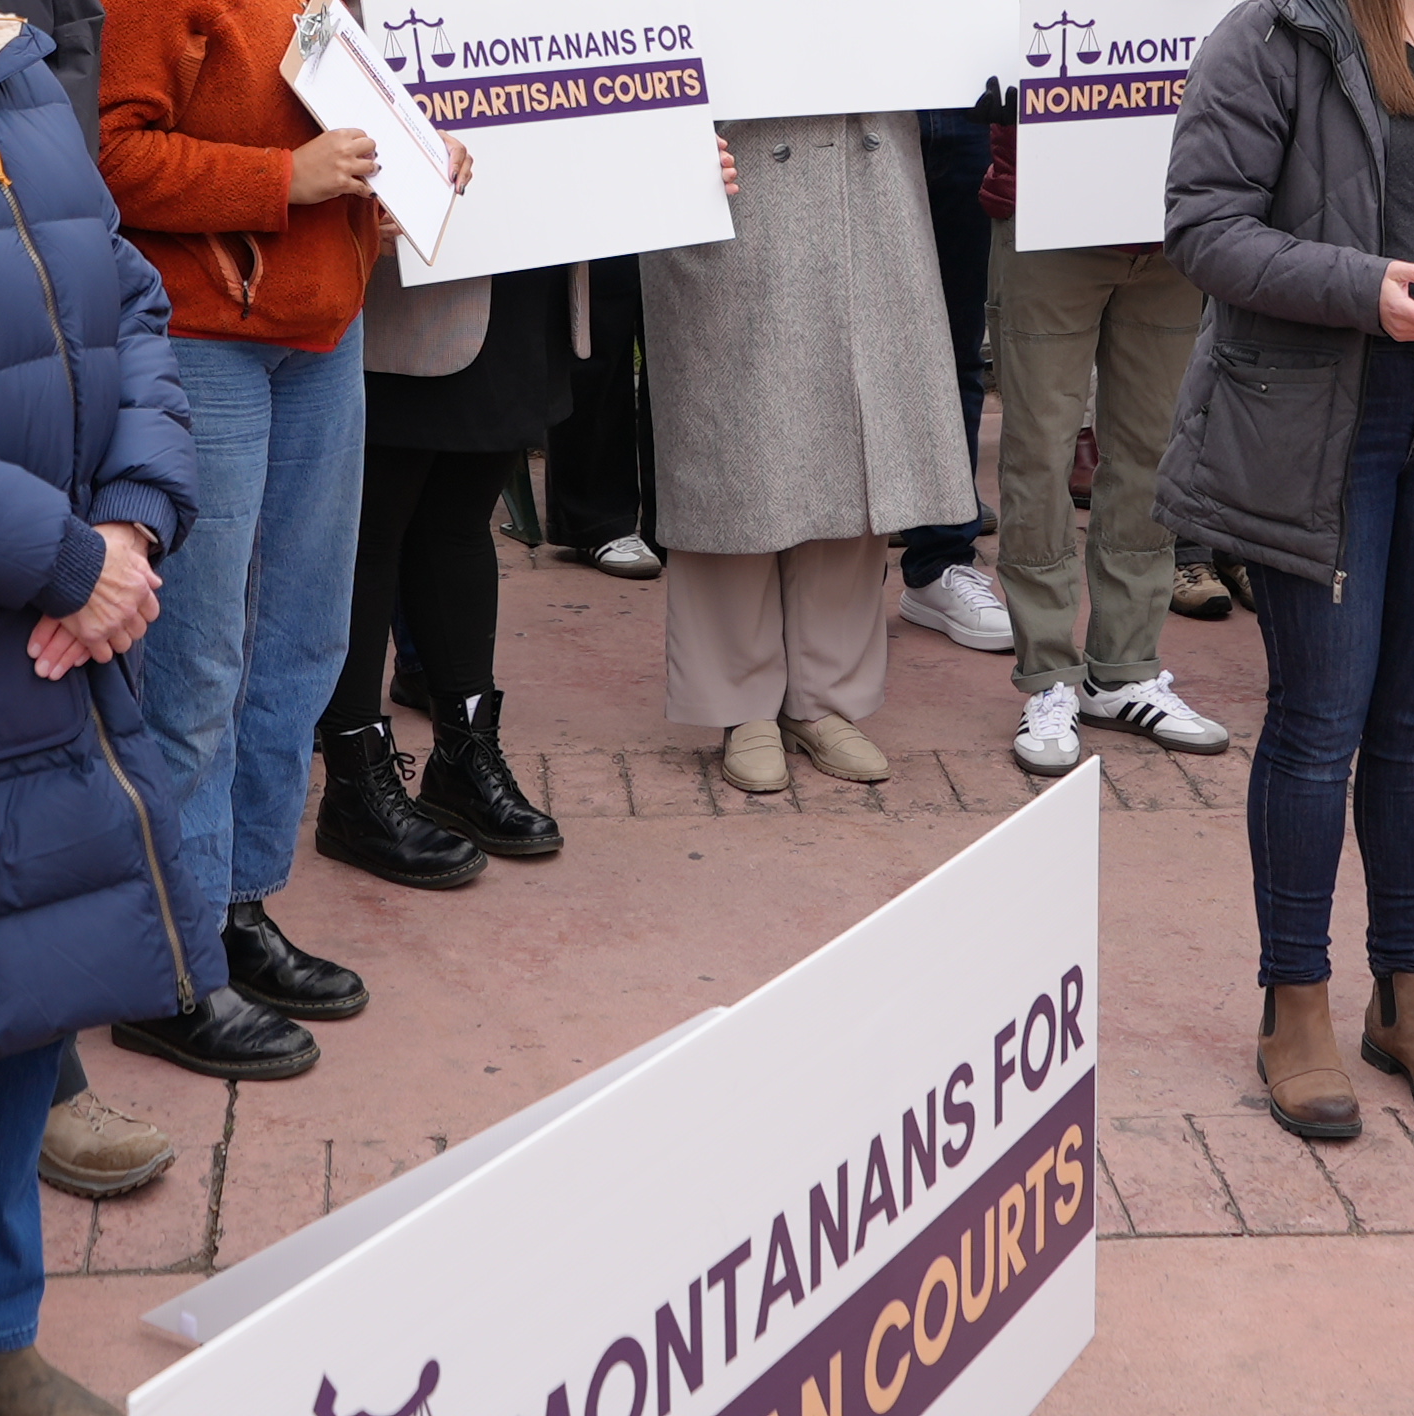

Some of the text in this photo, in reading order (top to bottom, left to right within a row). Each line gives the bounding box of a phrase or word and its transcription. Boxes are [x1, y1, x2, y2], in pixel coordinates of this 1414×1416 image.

[463, 24, 694, 69] MONTANANS FOR
[412, 68, 702, 123] ONPARTISAN COURTS
[1025, 78, 1187, 116] NONPARTIS
[994, 963, 1085, 1128] FOR
[863, 1123, 1084, 1415] COURTS
